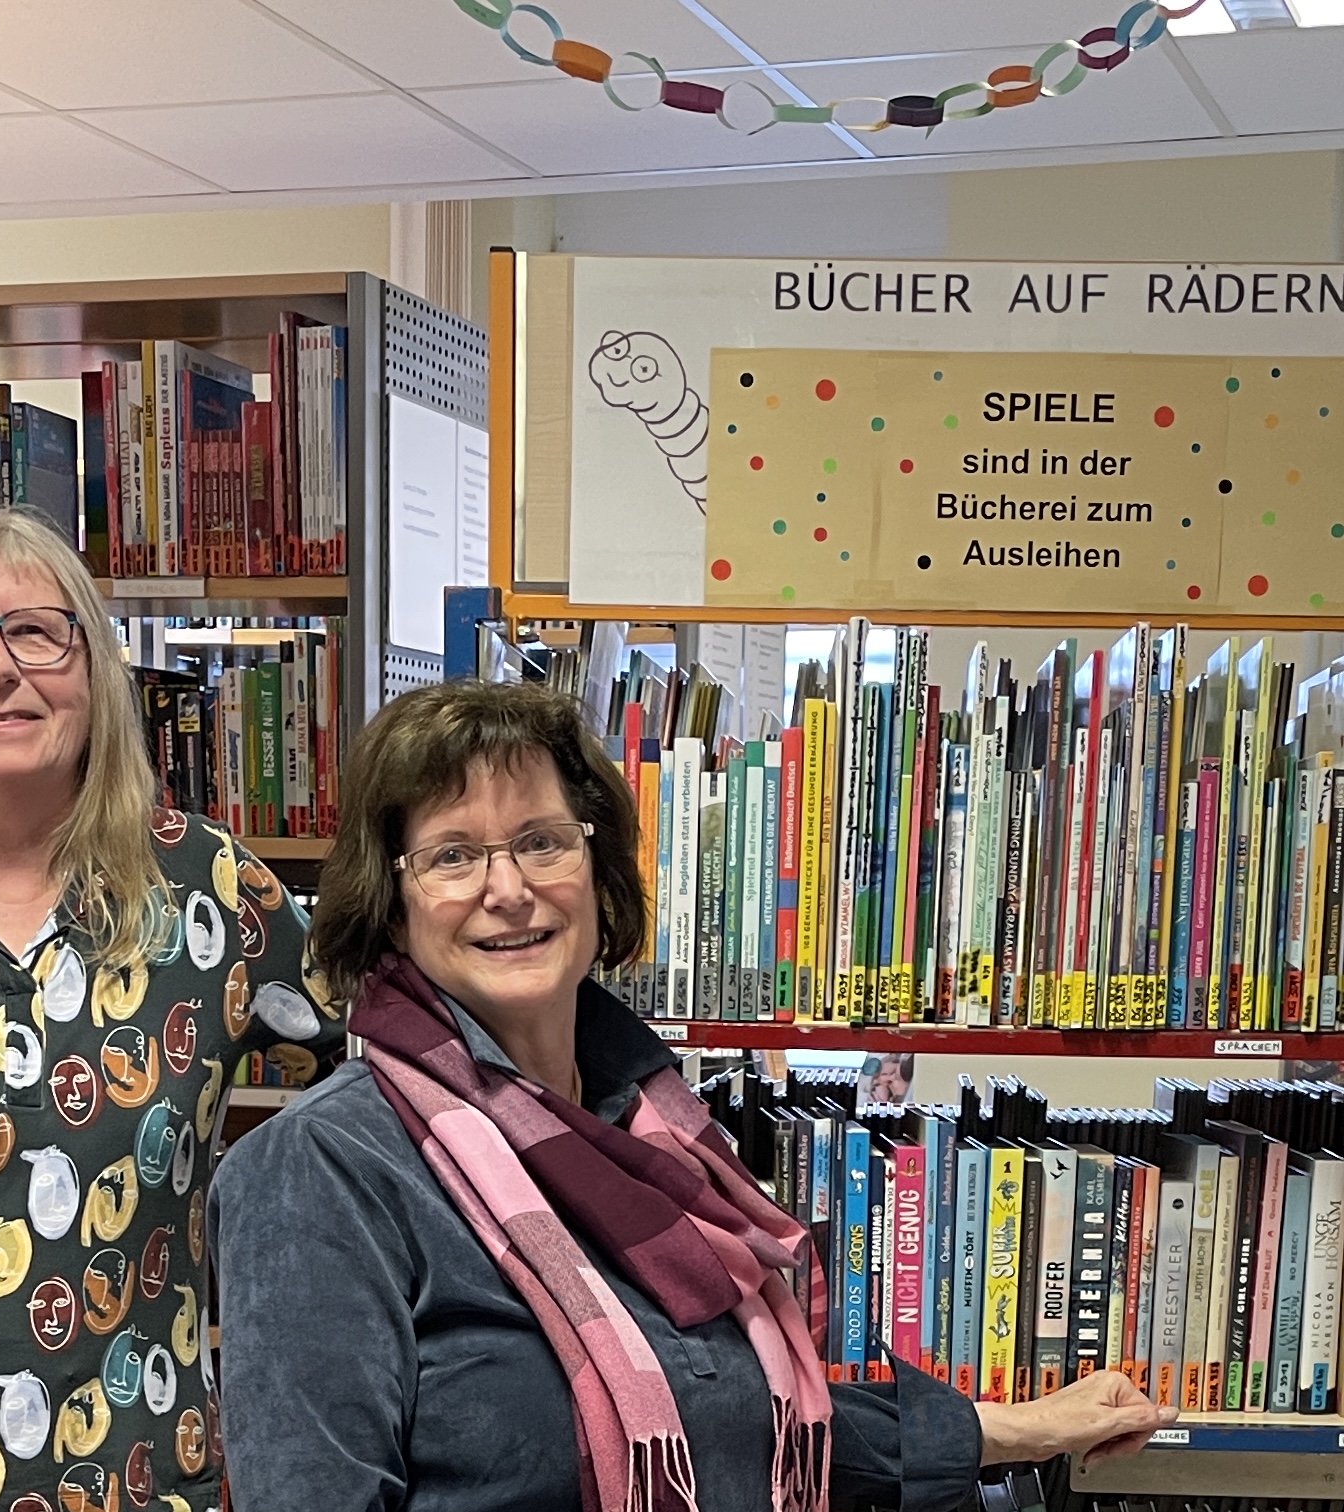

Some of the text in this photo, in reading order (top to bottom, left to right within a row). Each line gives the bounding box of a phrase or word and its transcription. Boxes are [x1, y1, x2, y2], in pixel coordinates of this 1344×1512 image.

[773, 262, 972, 313] BÜCHER
[1008, 273, 1109, 313] AUF
[983, 392, 1115, 423] SPIELE
[161, 408, 173, 469] Sapiens
[963, 448, 1131, 475] sind in der
[937, 493, 1152, 522] Bücherei zum
[963, 540, 1120, 568] Ausleihen
[262, 690, 274, 777] BESSER NICHT
[679, 817, 690, 840] statt
[784, 800, 795, 869] Bildwörterbuch
[1218, 1040, 1281, 1052] SPRACHEN
[871, 1216, 882, 1271] PREMIUM
[897, 1190, 919, 1323] NICHT GENUG
[848, 1225, 864, 1350] SNOOPY SO COOL!
[1044, 1262, 1064, 1319] ROOFER
[1078, 1212, 1105, 1356] INFERNIA
[1163, 1244, 1182, 1346] FREESTYLER
[1193, 1269, 1204, 1302] JUDITH
